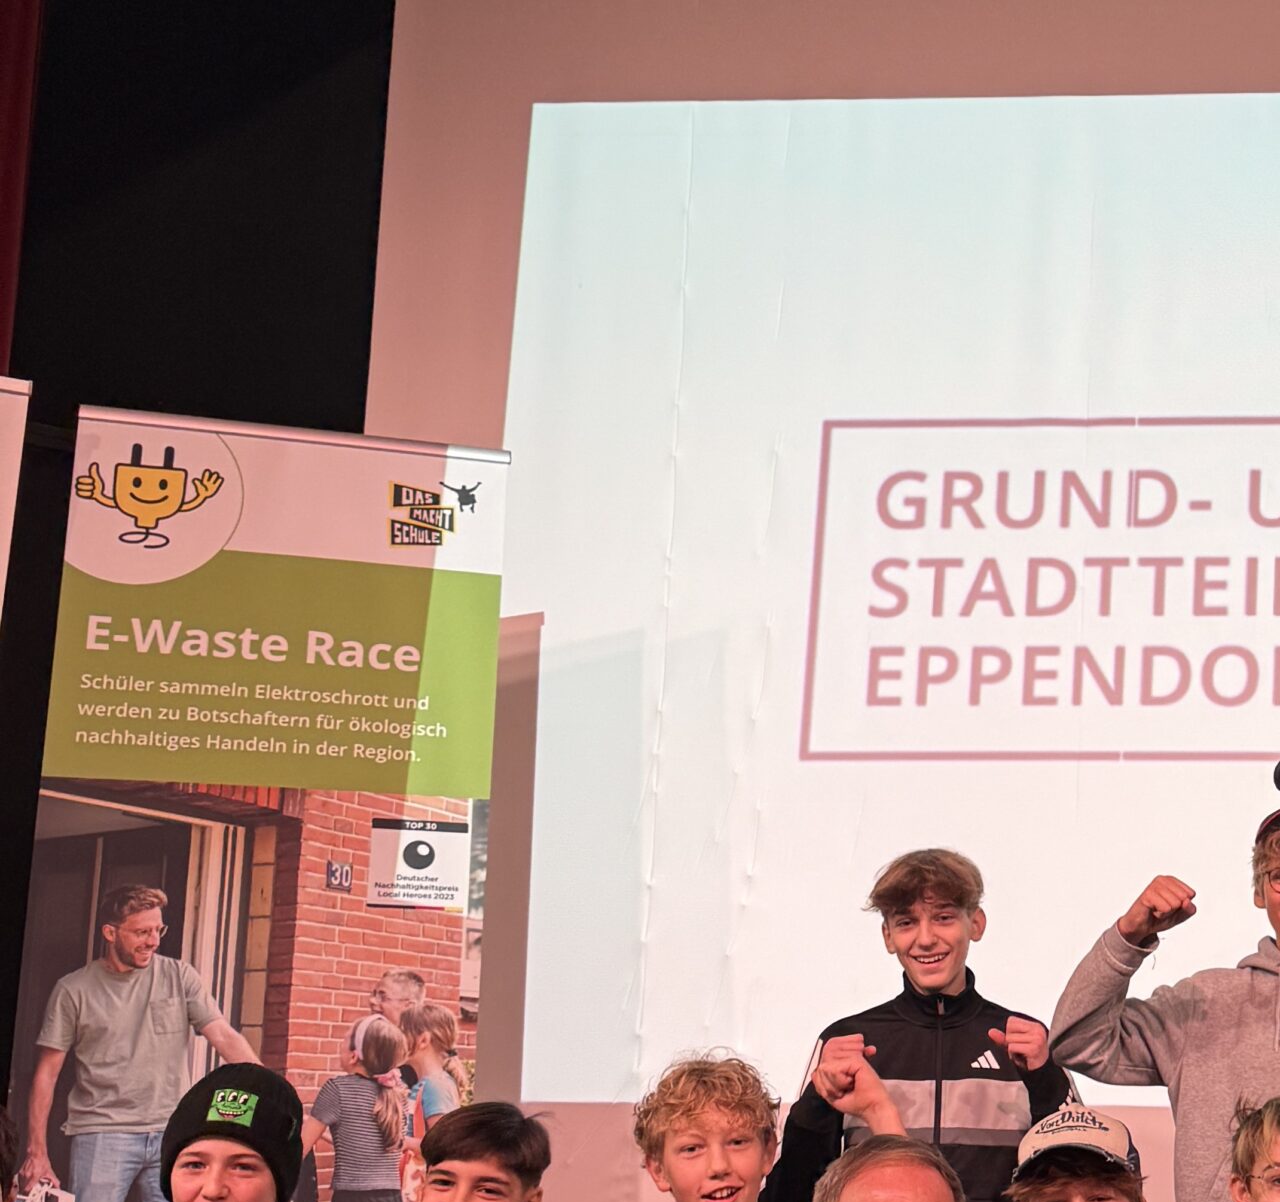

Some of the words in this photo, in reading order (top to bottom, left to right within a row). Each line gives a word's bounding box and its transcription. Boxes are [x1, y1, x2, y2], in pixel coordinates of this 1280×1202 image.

[401, 487, 433, 505] DAS
[877, 468, 1212, 530] GRUND-
[413, 509, 451, 530] MACHT
[393, 522, 440, 543] SCHULE
[85, 614, 289, 662] E-Waste
[305, 630, 421, 672] Race
[80, 674, 155, 692] Schüler
[159, 681, 249, 698] sammeln
[254, 684, 389, 708] Elektroschrott
[394, 695, 430, 710] und
[77, 702, 152, 719] werden
[158, 708, 181, 721] zu
[186, 706, 310, 728] Botschaftern
[316, 713, 345, 730] für
[349, 716, 447, 739] ökologisch
[75, 729, 201, 751] nachhaltiges
[206, 734, 287, 753] Handeln
[292, 739, 310, 754] in
[315, 741, 348, 757] der
[353, 743, 421, 764] Region.
[405, 821, 424, 829] TOP
[331, 863, 352, 887] 30
[396, 874, 439, 883] Deutscher
[374, 882, 459, 893] Nachhaltigkeitspreis
[377, 890, 401, 898] Local
[402, 891, 432, 900] Heroes
